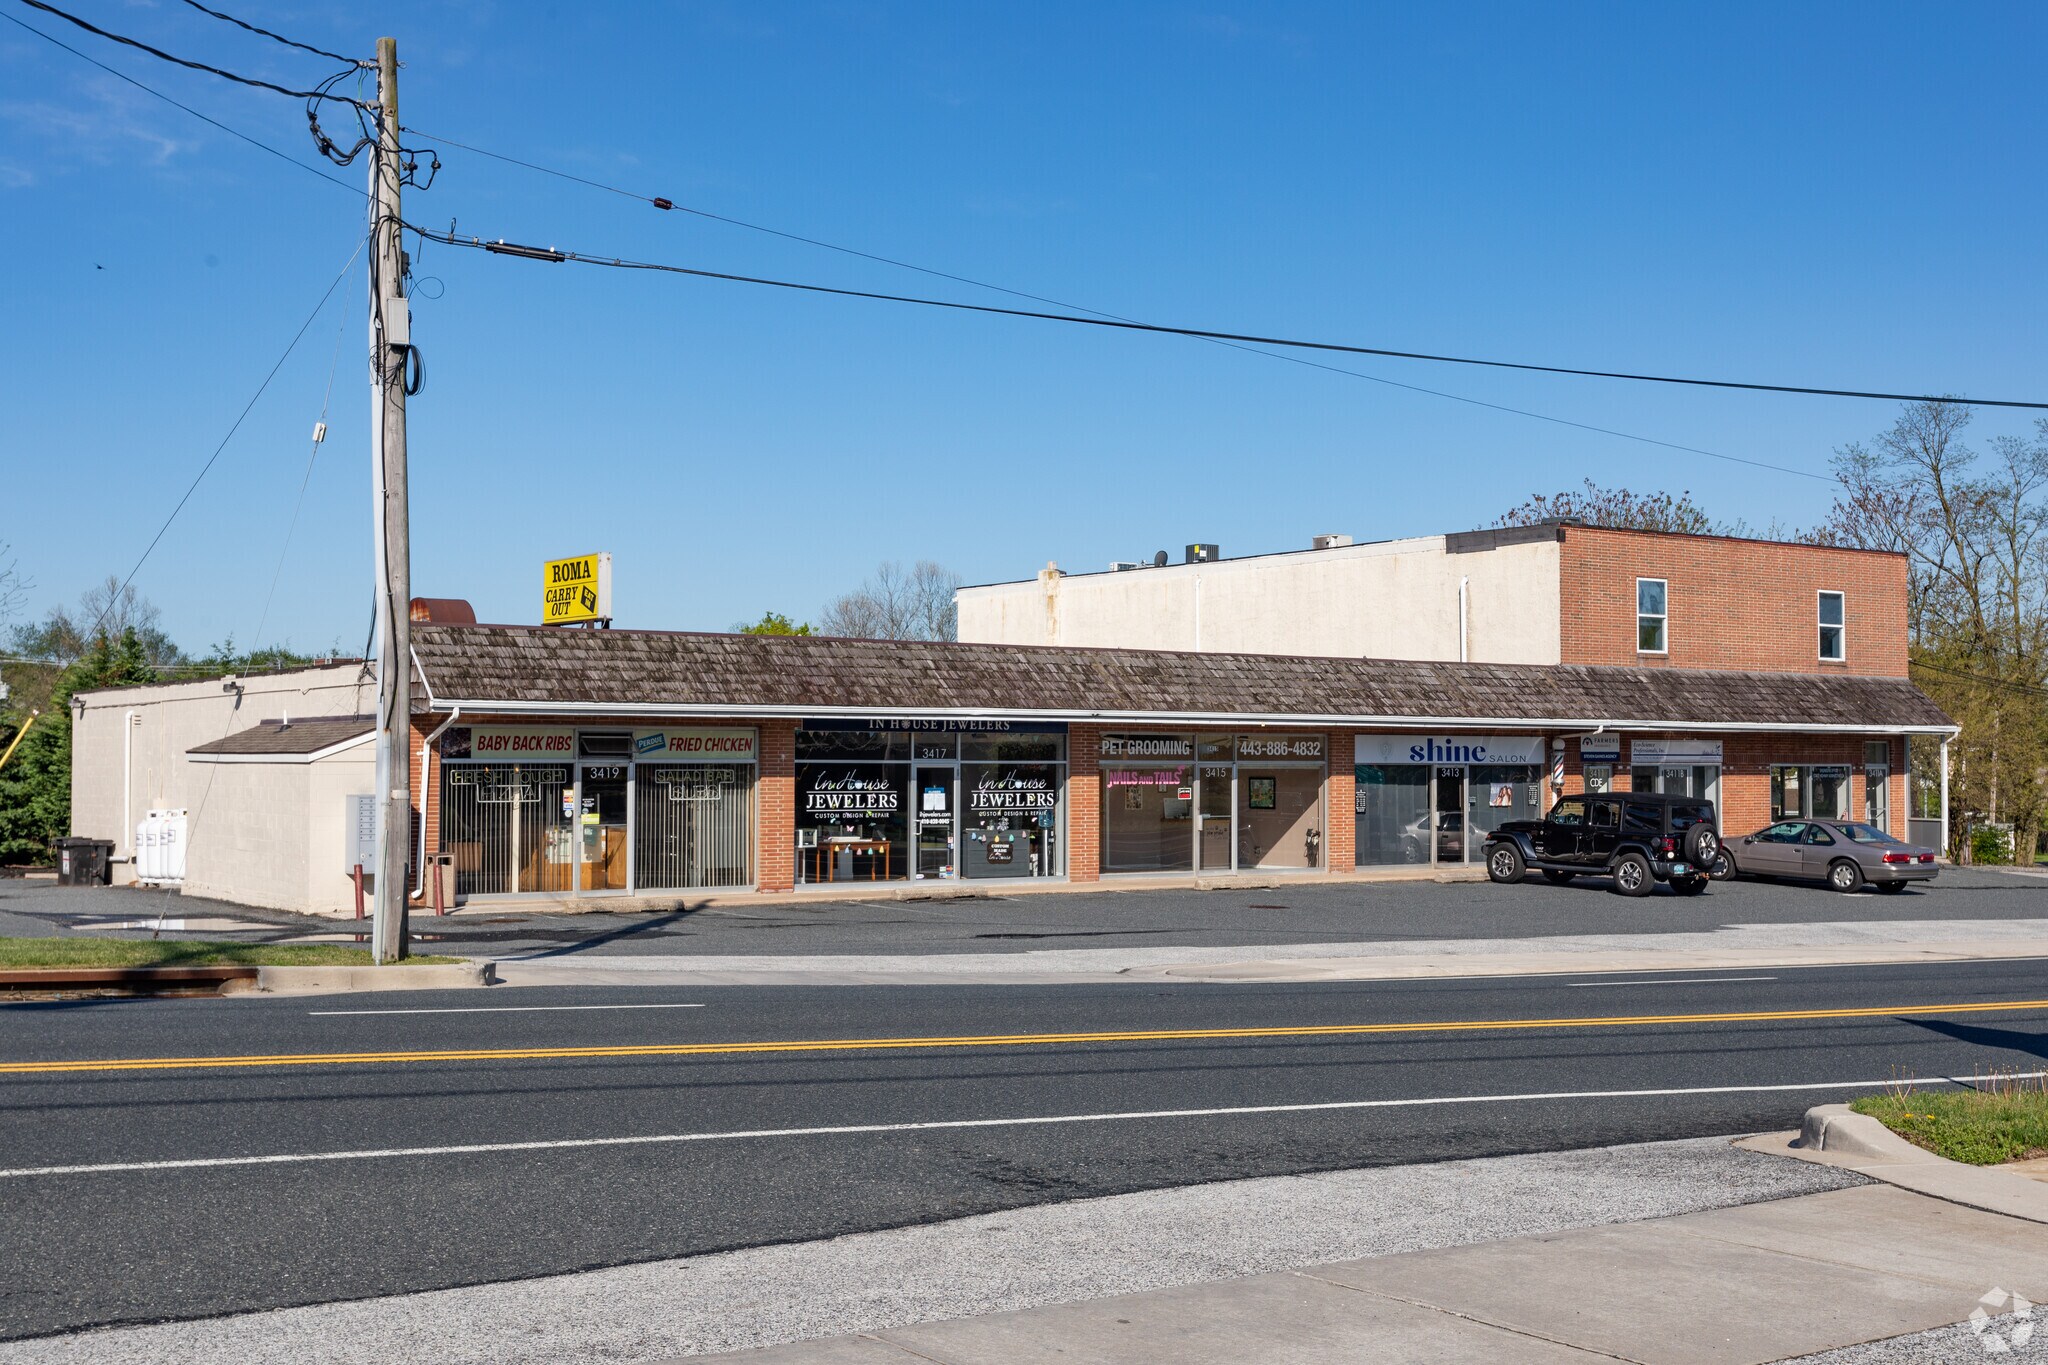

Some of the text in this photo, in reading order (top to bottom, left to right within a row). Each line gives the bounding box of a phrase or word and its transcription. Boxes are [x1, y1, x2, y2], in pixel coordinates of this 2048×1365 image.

[552, 560, 591, 583] ROMA
[546, 586, 578, 603] CARRY
[551, 602, 571, 616] OUT
[869, 719, 884, 729] IN
[941, 720, 1010, 732] JEWELERS
[477, 735, 572, 751] BABY BACK RIBS
[638, 735, 663, 748] PERDUE
[669, 737, 753, 751] FRIED CHICKEN
[1101, 741, 1124, 755] PET
[1127, 740, 1190, 755] GROOMING
[922, 748, 947, 759] 3417
[1240, 742, 1321, 756] 443-886-4832
[1409, 737, 1527, 763] shine SALON
[591, 767, 619, 779] 3419
[657, 770, 733, 782] SALAD BAR
[1107, 765, 1186, 788] NAILS AND TAILS
[1205, 767, 1226, 778] 3415
[1441, 767, 1460, 778] 3413
[1666, 769, 1684, 778] 3411B
[806, 793, 898, 809] JEWELERS
[971, 792, 1055, 807] JEWELERS
